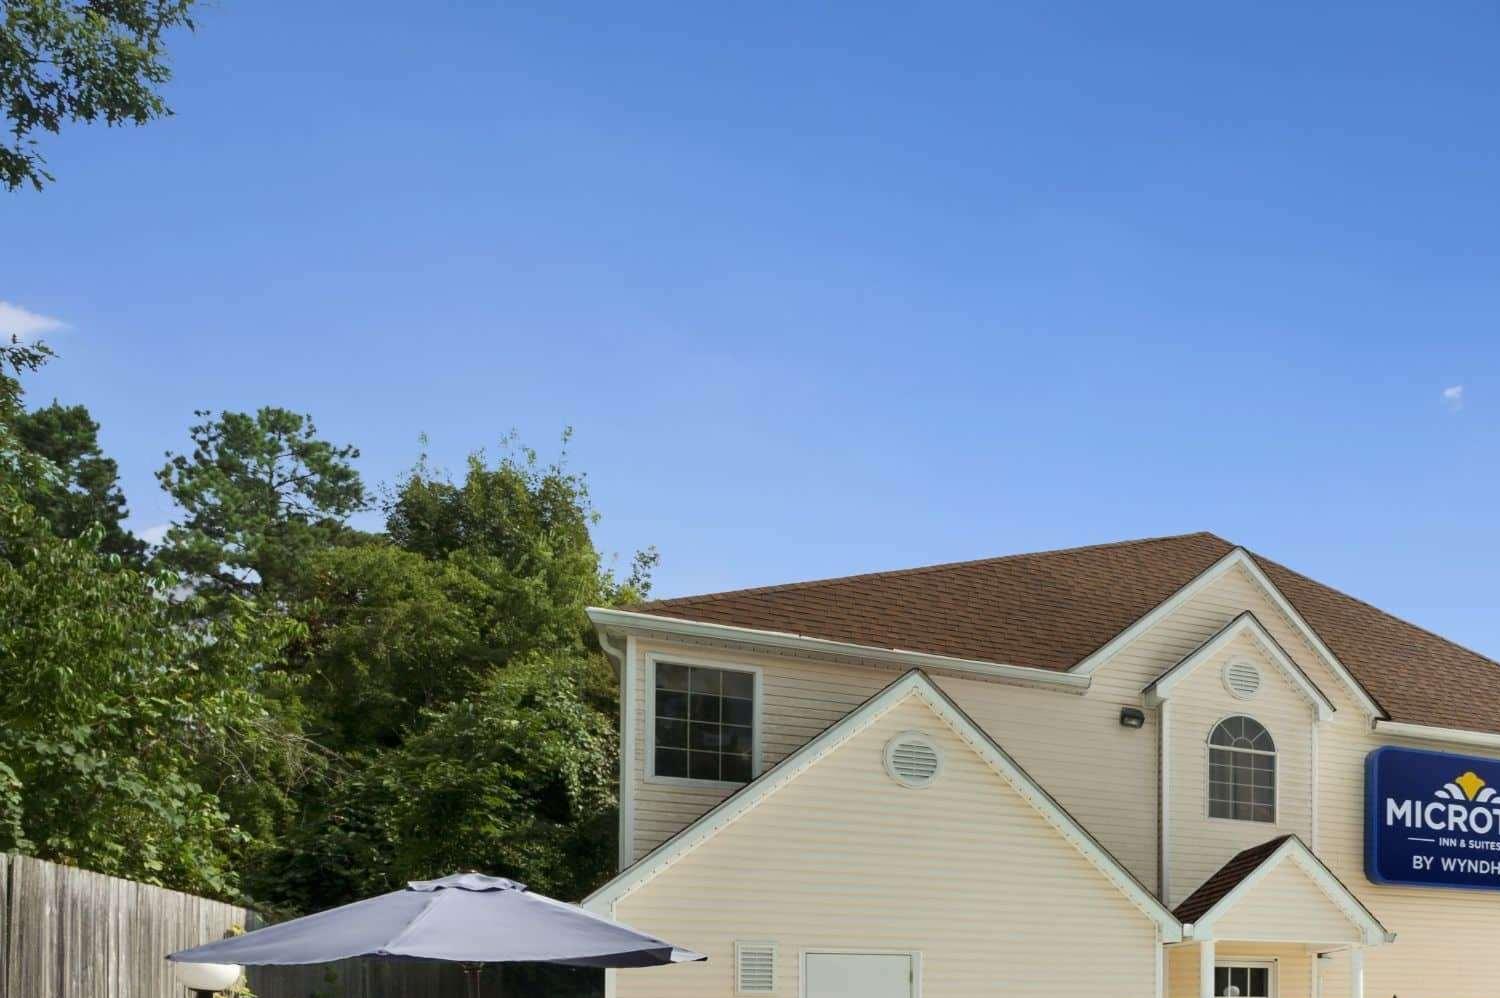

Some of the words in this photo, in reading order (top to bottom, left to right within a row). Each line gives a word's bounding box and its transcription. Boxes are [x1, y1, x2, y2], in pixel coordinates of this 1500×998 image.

[1438, 837, 1457, 848] INN
[1459, 839, 1466, 848] &
[1412, 855, 1434, 870] BY
